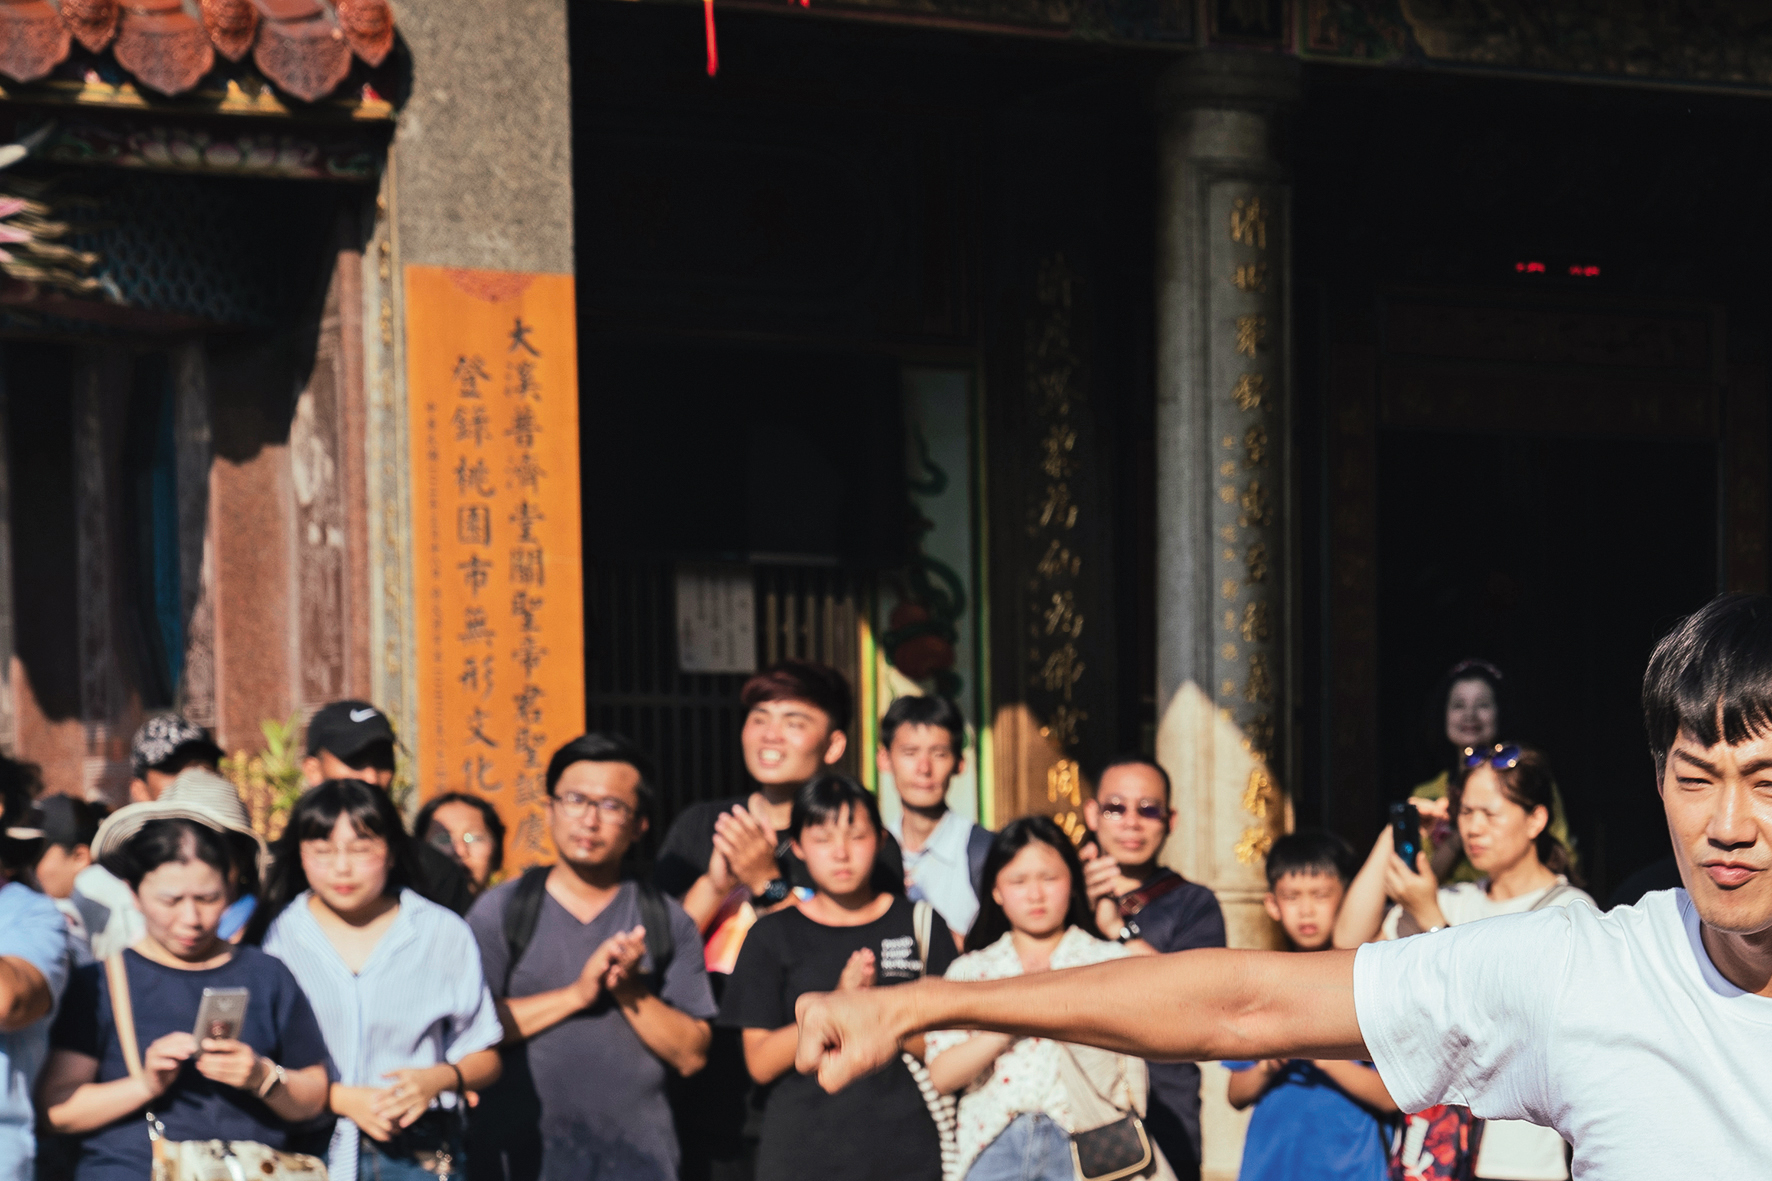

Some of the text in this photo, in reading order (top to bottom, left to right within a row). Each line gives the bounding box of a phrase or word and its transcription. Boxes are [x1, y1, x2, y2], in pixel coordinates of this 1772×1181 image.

[503, 315, 548, 873] 大溪普濟堂關聖帝君聖誕慶
